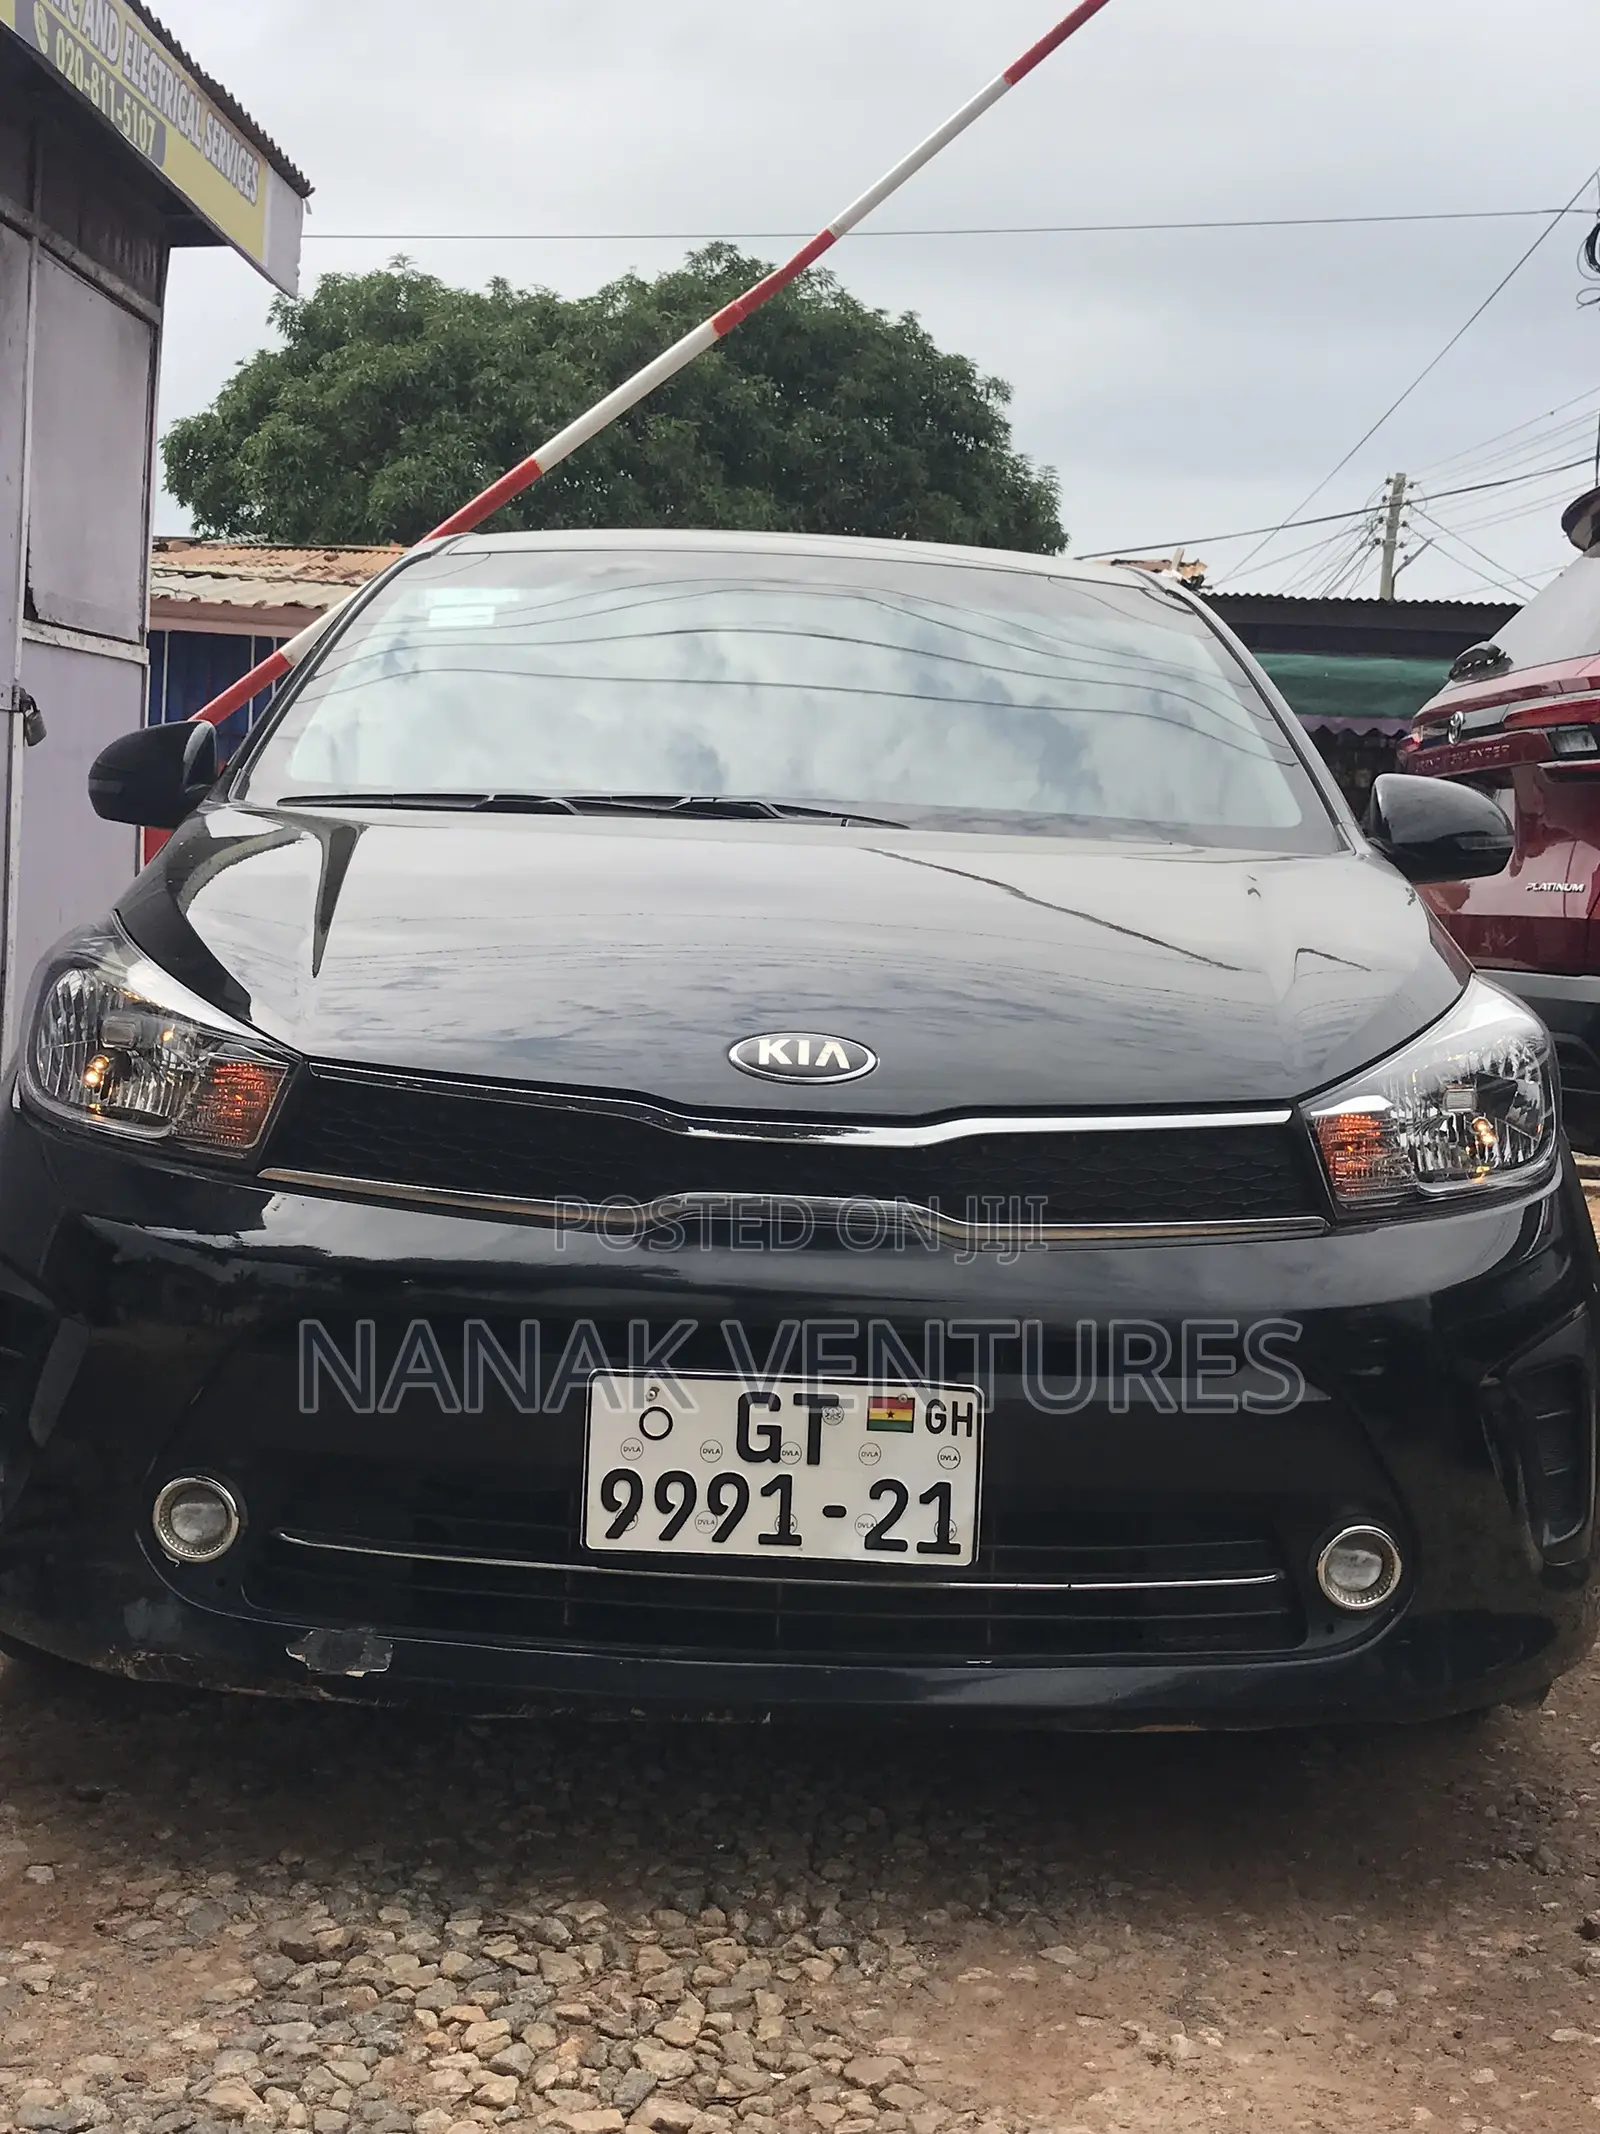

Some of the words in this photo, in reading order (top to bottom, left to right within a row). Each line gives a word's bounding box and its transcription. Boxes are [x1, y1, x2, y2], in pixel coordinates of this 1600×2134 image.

[56, 28, 156, 157] 020-811-5107
[81, 0, 119, 62] AND
[122, 25, 201, 149] ELECTRICAL
[204, 112, 259, 203] SERVICES
[1525, 882, 1585, 892] PLATINUM
[758, 1039, 850, 1069] KIA
[736, 1391, 840, 1465] GT
[925, 1399, 973, 1437] GH
[623, 1445, 641, 1453] DVLA
[702, 1447, 721, 1455] DVLA
[781, 1449, 800, 1457] DVLA
[861, 1450, 879, 1458] DVLA
[940, 1454, 958, 1463] DVLA
[601, 1468, 962, 1555] 9991-21
[697, 1518, 716, 1526] DVLA
